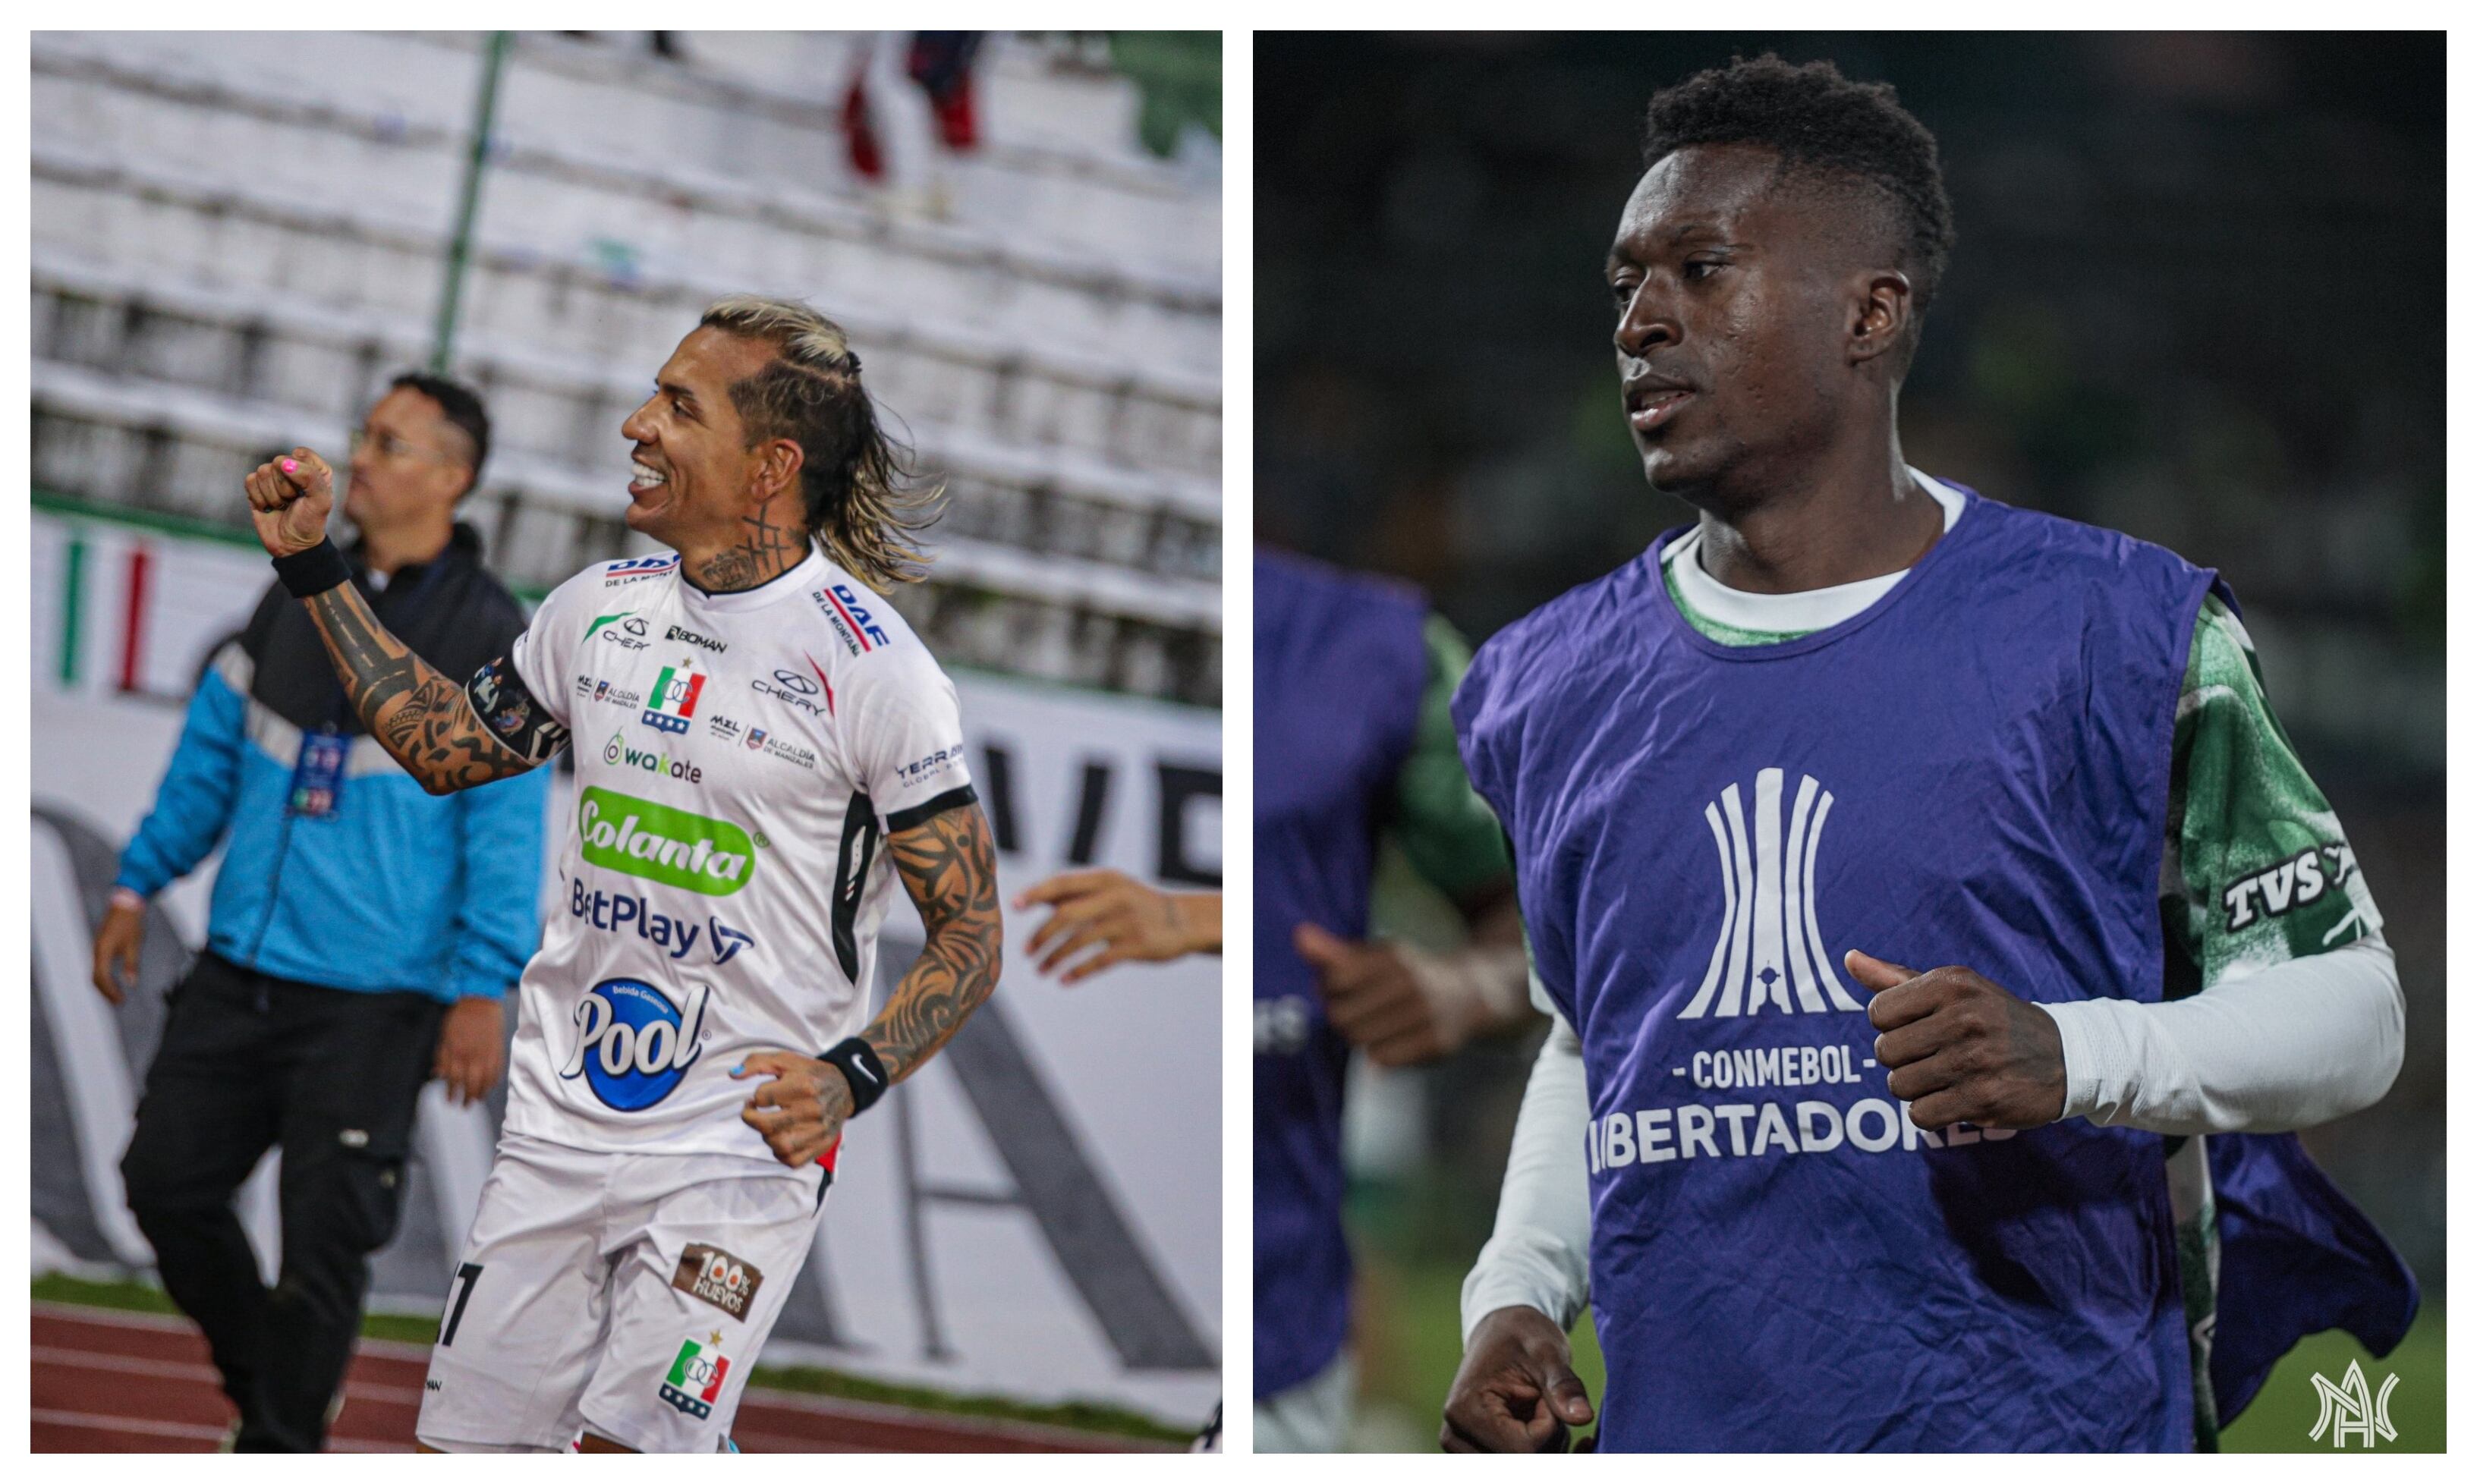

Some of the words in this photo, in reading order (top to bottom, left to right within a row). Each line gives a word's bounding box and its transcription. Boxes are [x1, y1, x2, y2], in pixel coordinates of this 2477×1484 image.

[605, 579, 620, 588] DE
[812, 591, 826, 603] DE
[821, 603, 834, 616] LA
[831, 584, 891, 646] DAF
[677, 630, 728, 654] BOMAN
[751, 679, 827, 717] CHERY
[766, 737, 815, 762] ALCALDÍA
[581, 799, 747, 882] Colanta
[2225, 850, 2324, 930] TVS
[571, 877, 700, 959] BetPlay
[612, 985, 639, 997] Bebida
[559, 985, 710, 1080] Pool
[698, 1250, 752, 1295] 100%
[693, 1277, 744, 1313] HUEVOS
